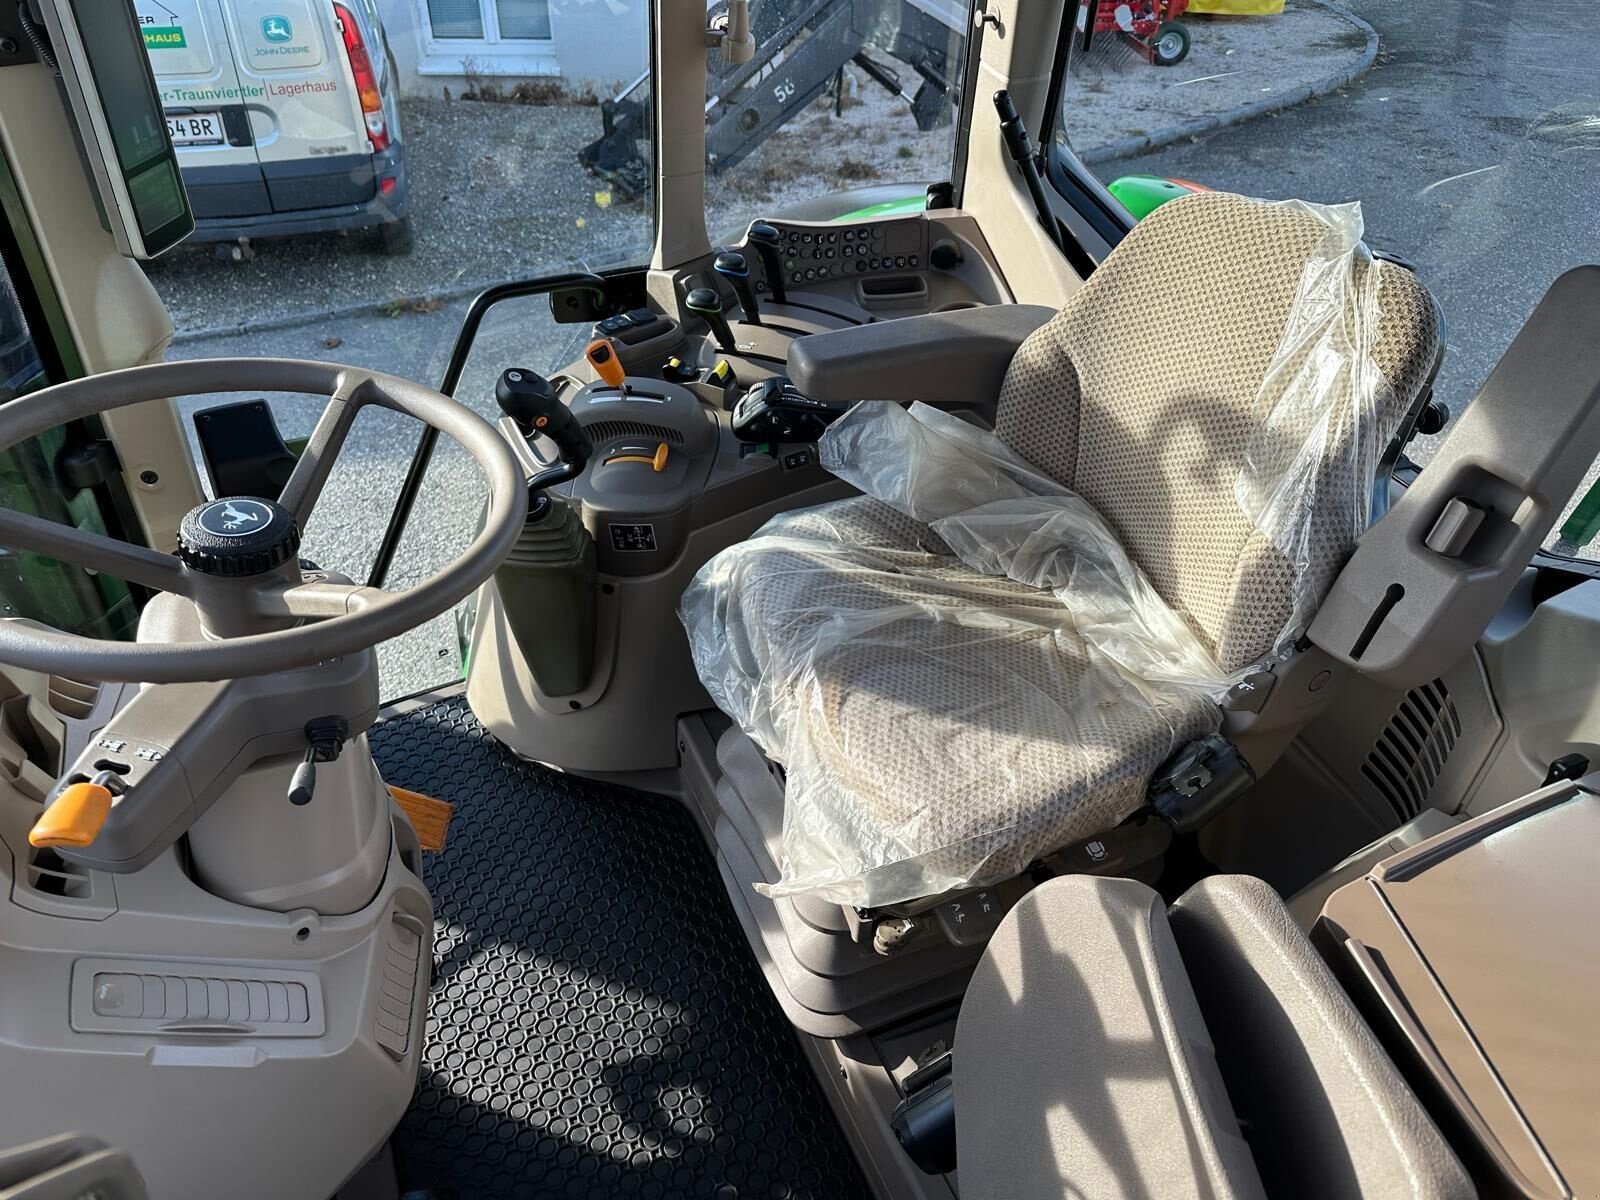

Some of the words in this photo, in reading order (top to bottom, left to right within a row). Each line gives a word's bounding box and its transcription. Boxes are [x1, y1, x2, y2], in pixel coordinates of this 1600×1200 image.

[255, 46, 279, 57] JOHN
[279, 45, 311, 55] DEERE
[268, 80, 337, 98] Lagerhaus
[189, 118, 214, 136] BR
